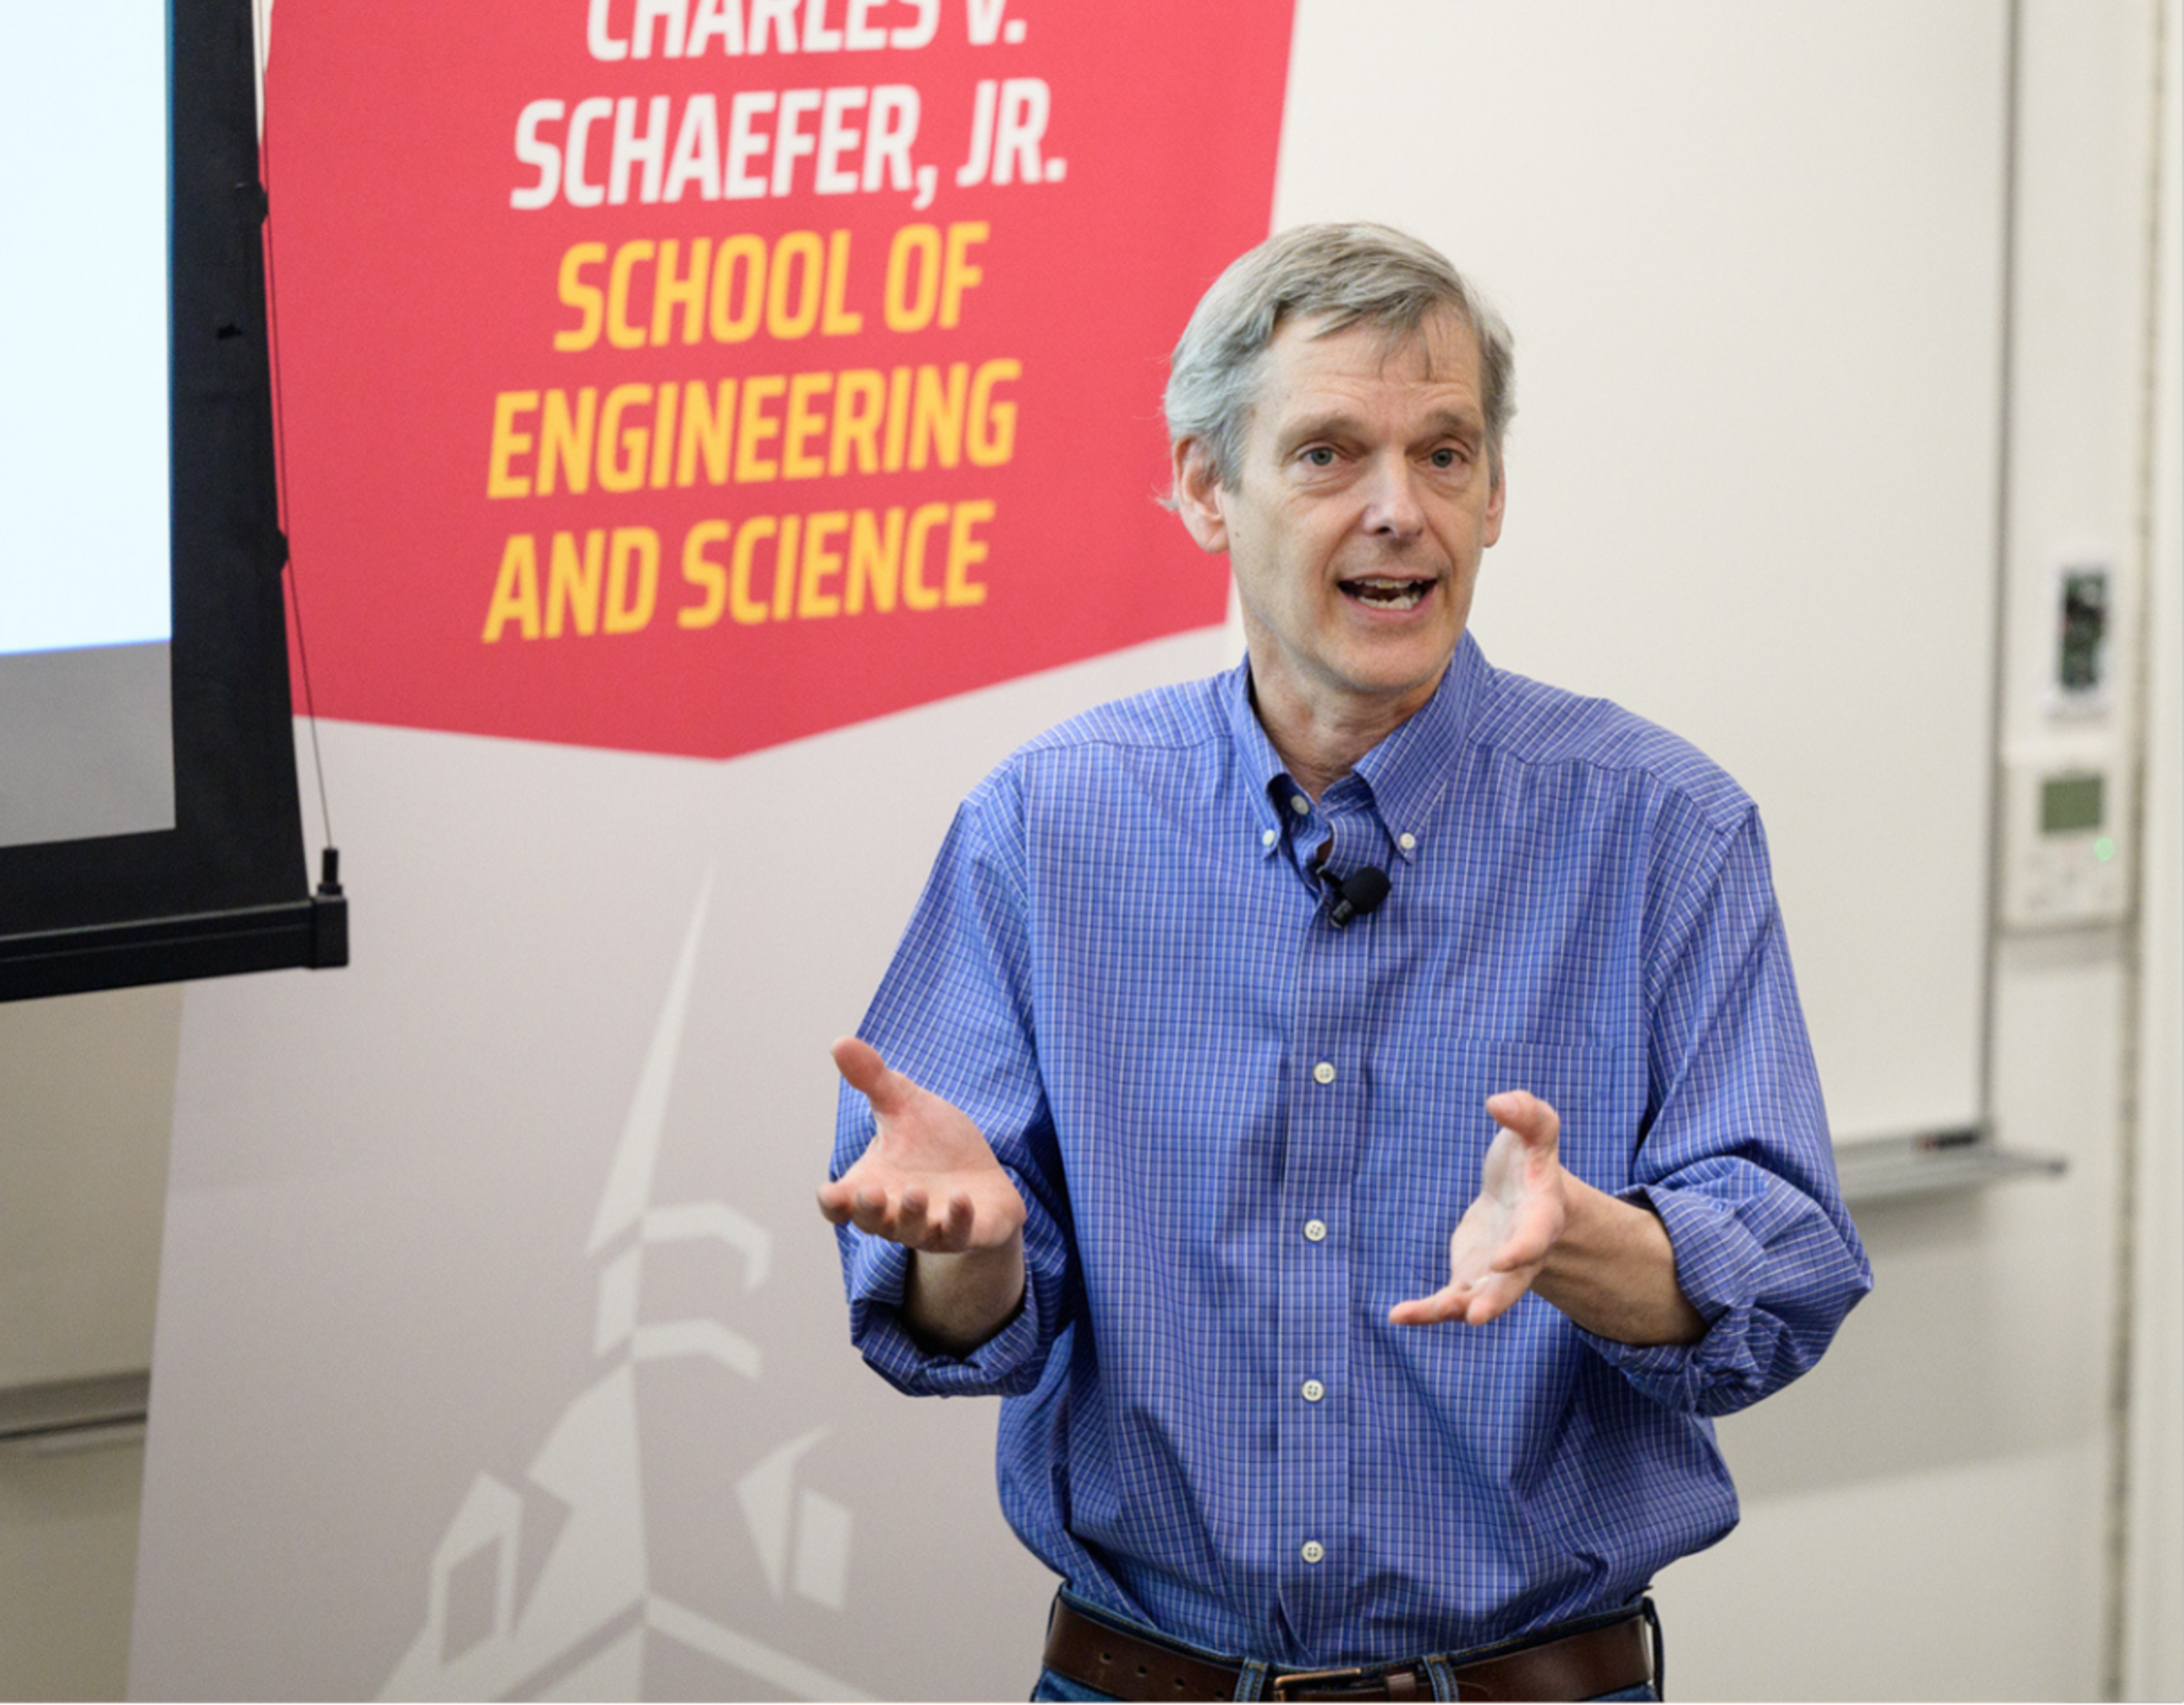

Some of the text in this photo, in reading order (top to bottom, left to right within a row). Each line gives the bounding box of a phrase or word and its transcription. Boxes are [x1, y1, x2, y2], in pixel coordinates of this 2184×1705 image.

[510, 76, 1067, 211] SCHAEFER, JR.
[553, 220, 990, 352] SCHOOL OF
[487, 358, 1022, 499] ENGINEERING
[482, 499, 996, 643] AND SCIENCE
